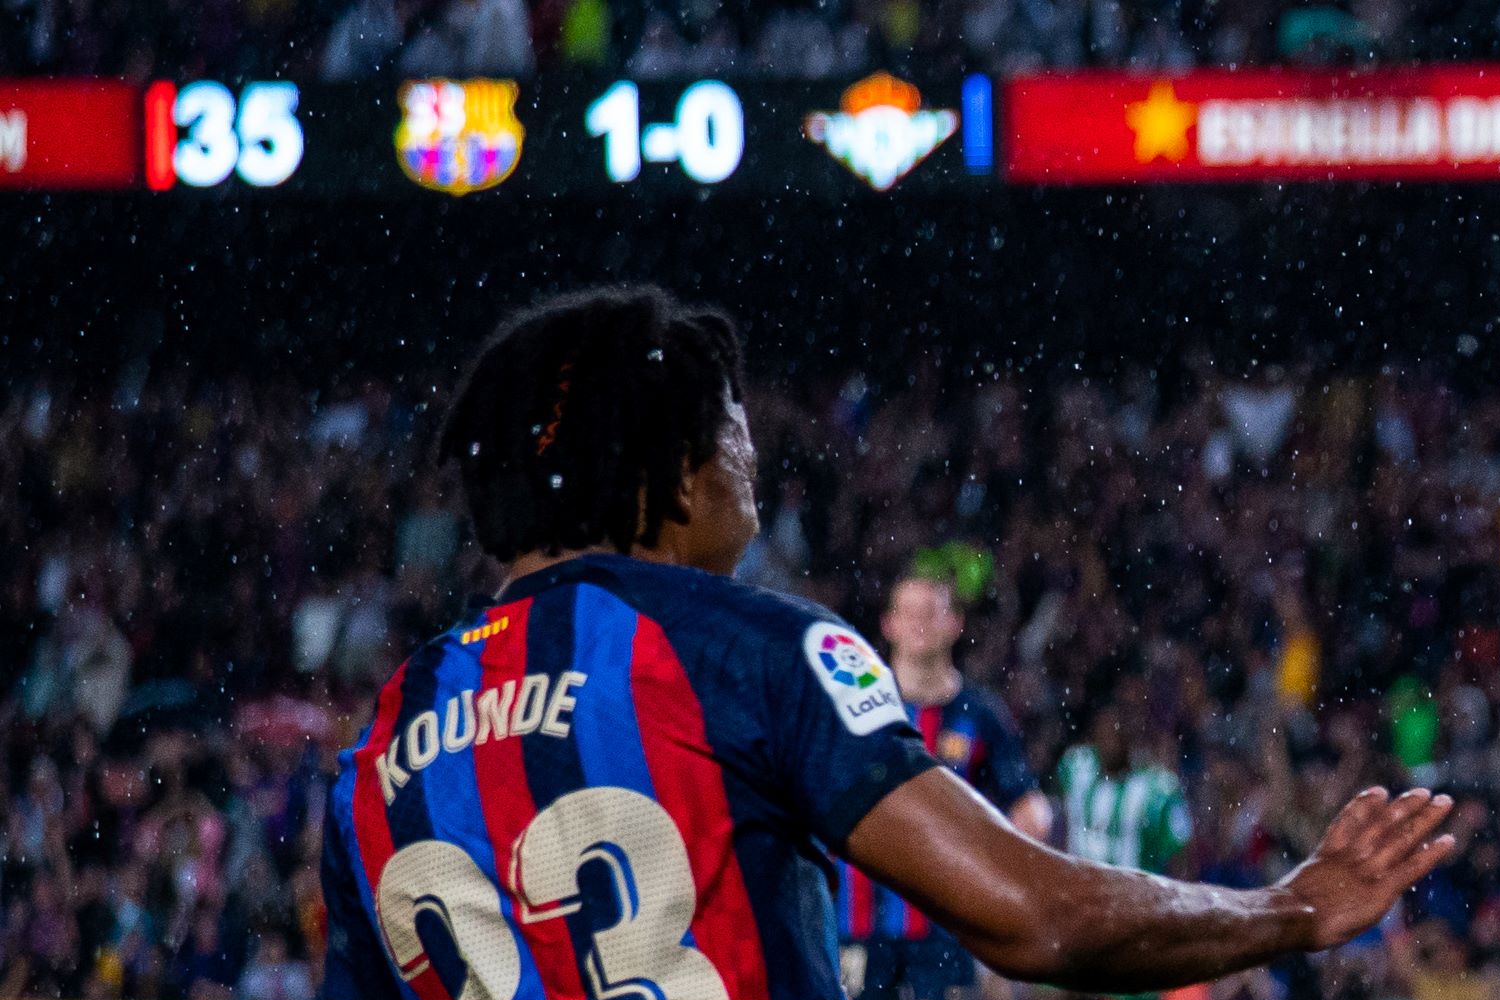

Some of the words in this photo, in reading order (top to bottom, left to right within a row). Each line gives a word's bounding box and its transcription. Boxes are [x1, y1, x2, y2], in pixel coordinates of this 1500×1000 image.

[173, 80, 304, 186] 35
[585, 80, 744, 183] 1-0
[376, 671, 588, 806] KOUNDE
